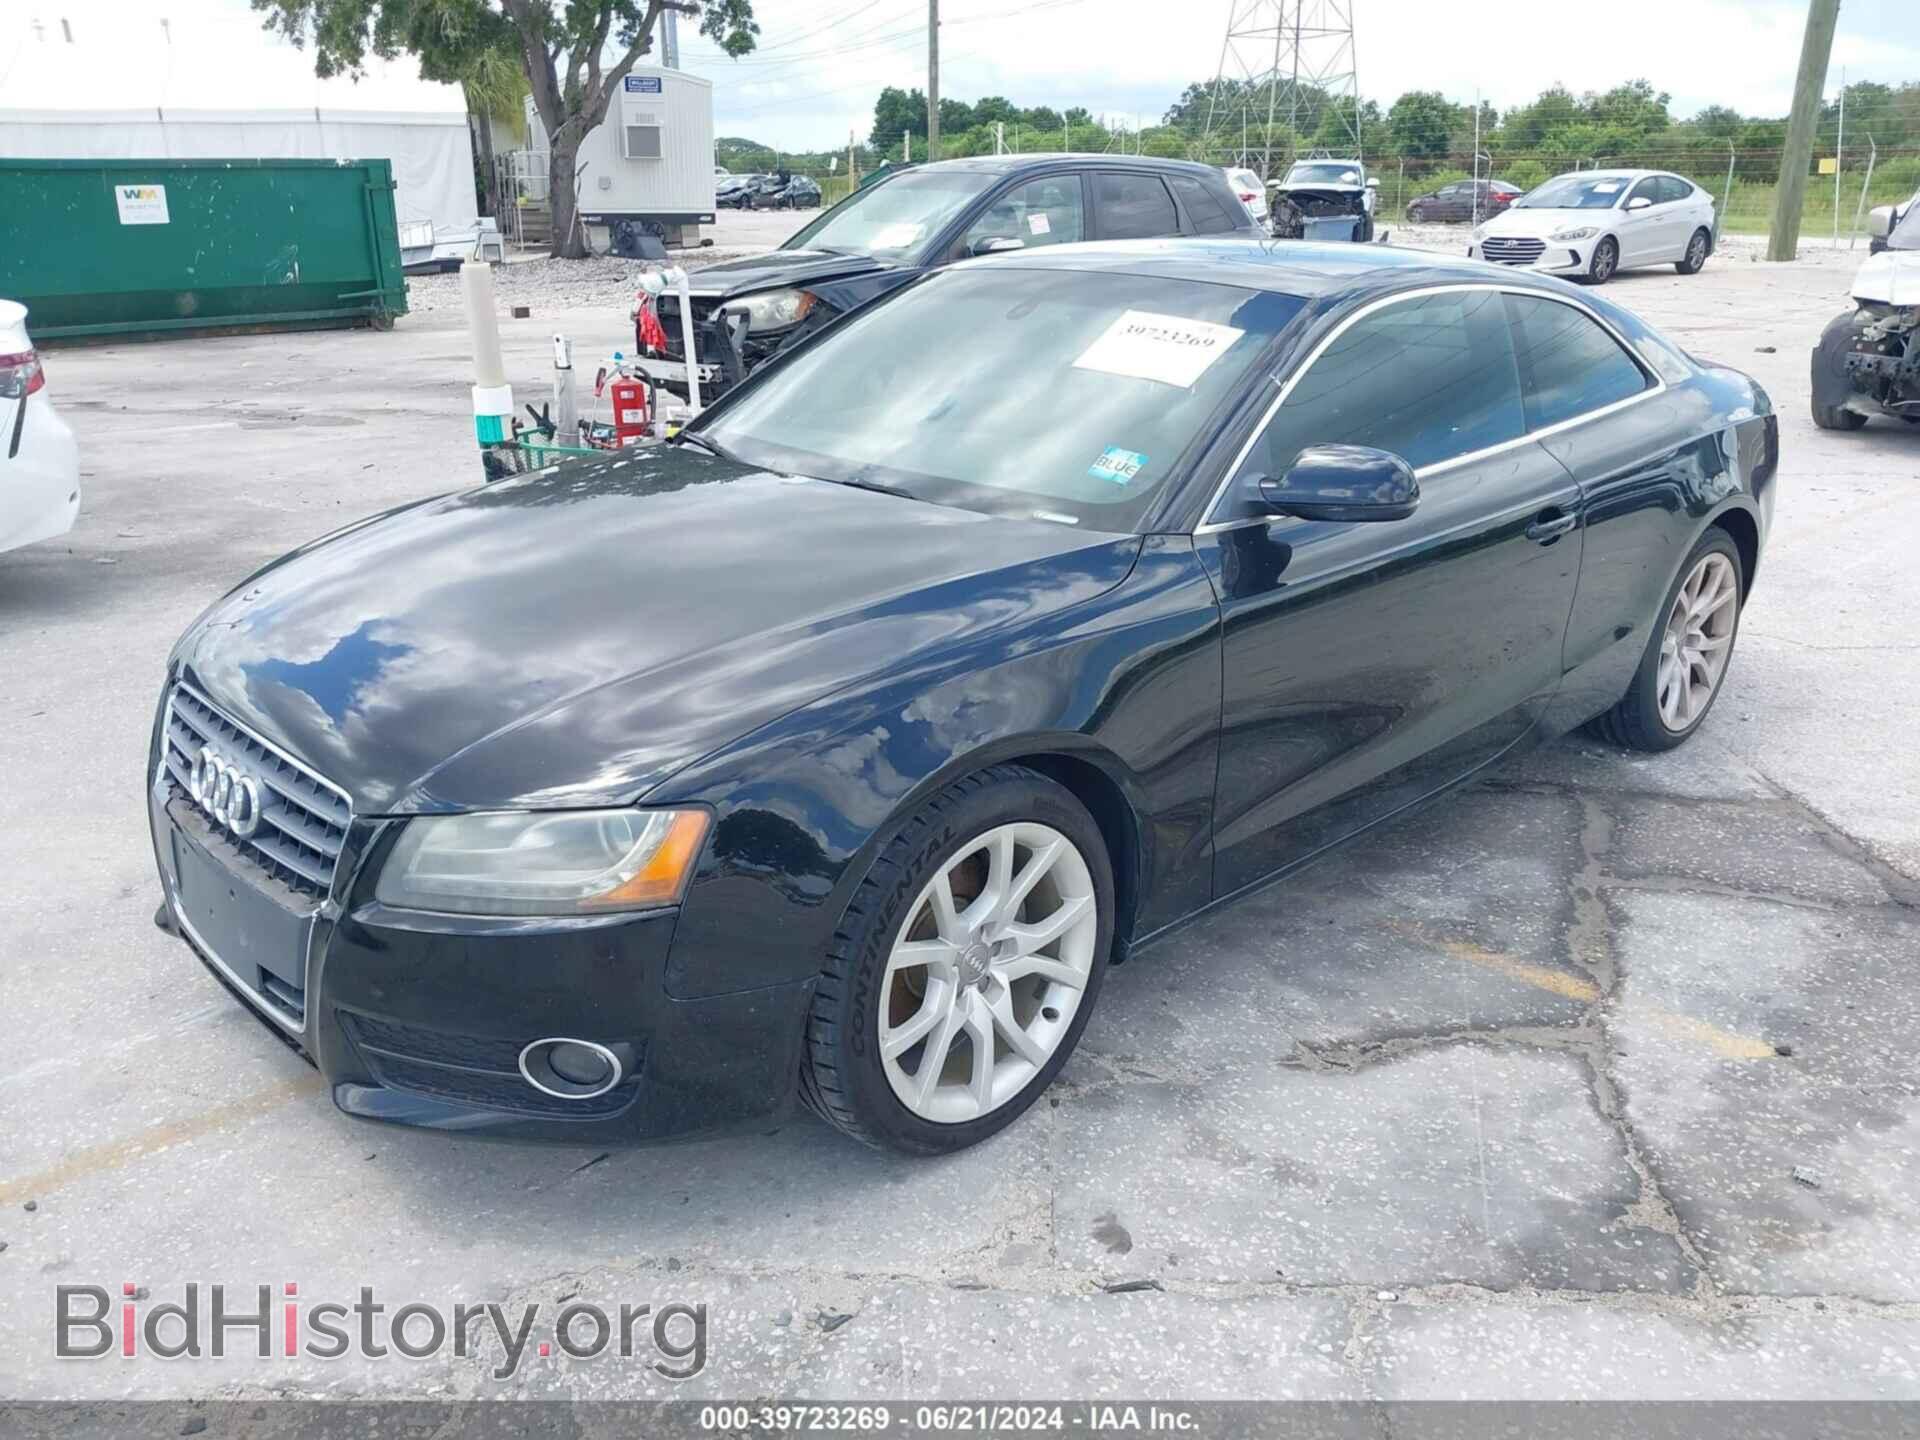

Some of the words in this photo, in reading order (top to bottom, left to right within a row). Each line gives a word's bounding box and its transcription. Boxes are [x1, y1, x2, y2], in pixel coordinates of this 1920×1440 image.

[123, 189, 158, 200] WM
[1094, 455, 1138, 477] BLUE
[851, 825, 958, 1058] CONTINENTAL
